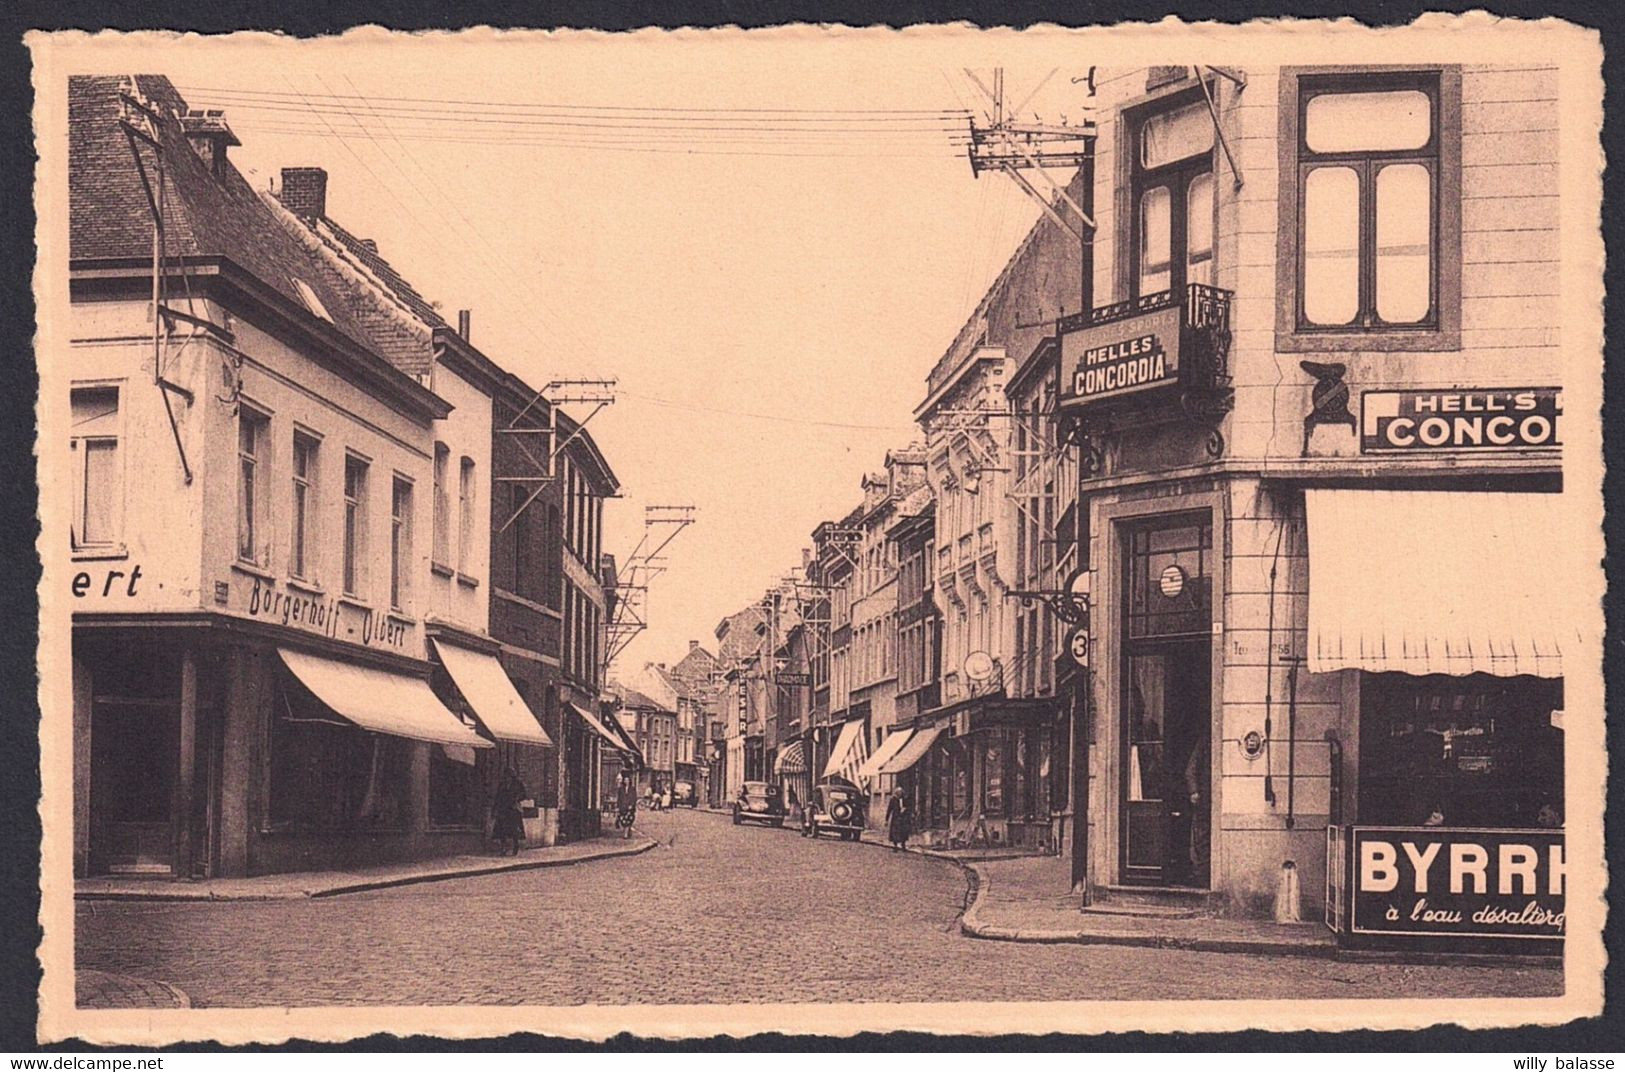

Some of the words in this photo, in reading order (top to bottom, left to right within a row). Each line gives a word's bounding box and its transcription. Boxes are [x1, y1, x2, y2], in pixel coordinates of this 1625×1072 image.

[1087, 337, 1152, 365] HELLES
[1075, 354, 1165, 395] CONCORDIA
[1415, 391, 1537, 412] HELL'S
[1386, 415, 1562, 446] CONCO
[71, 564, 142, 598] ert
[249, 577, 340, 638] Borgerhoff
[362, 609, 405, 647] Olbert
[1073, 635, 1087, 657] 3
[1385, 903, 1399, 921] à
[1410, 898, 1462, 922] l'eau
